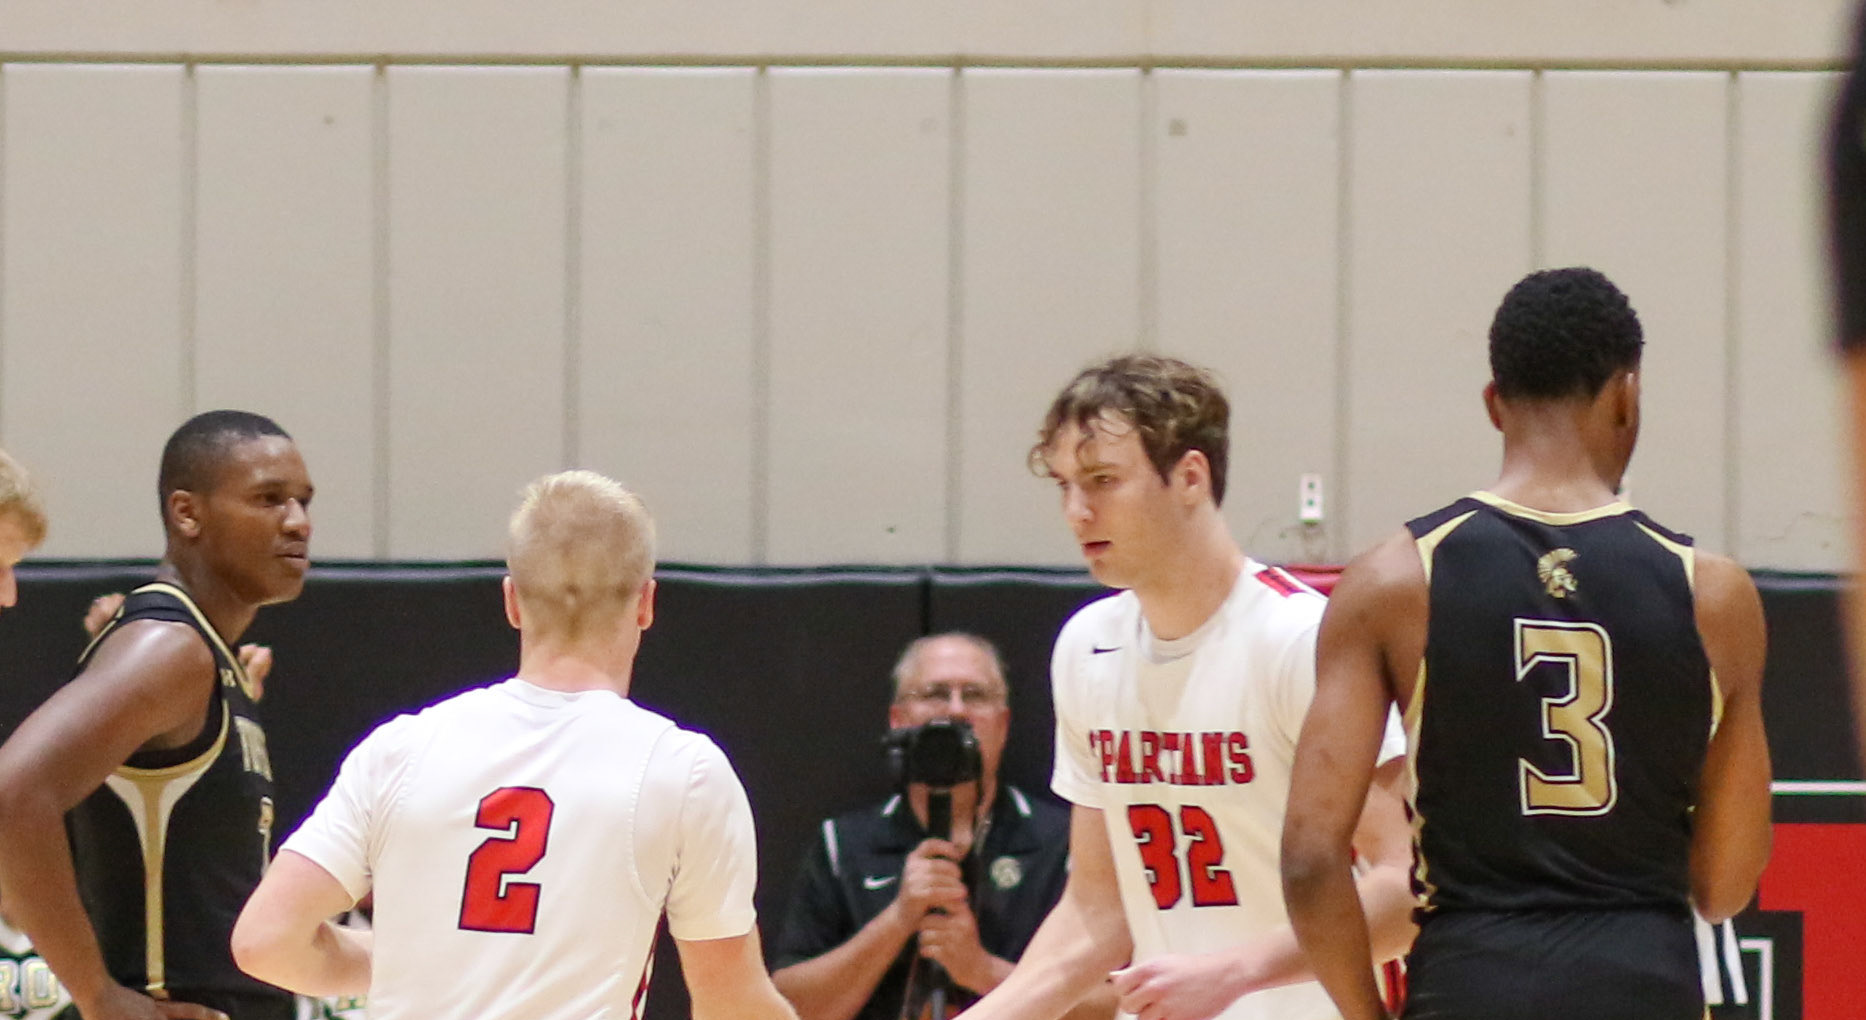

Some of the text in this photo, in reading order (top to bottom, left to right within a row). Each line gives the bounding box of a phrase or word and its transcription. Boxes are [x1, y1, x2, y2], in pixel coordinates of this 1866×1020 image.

[1514, 618, 1617, 816] 3
[458, 786, 555, 934] 2
[1126, 803, 1240, 911] 32
